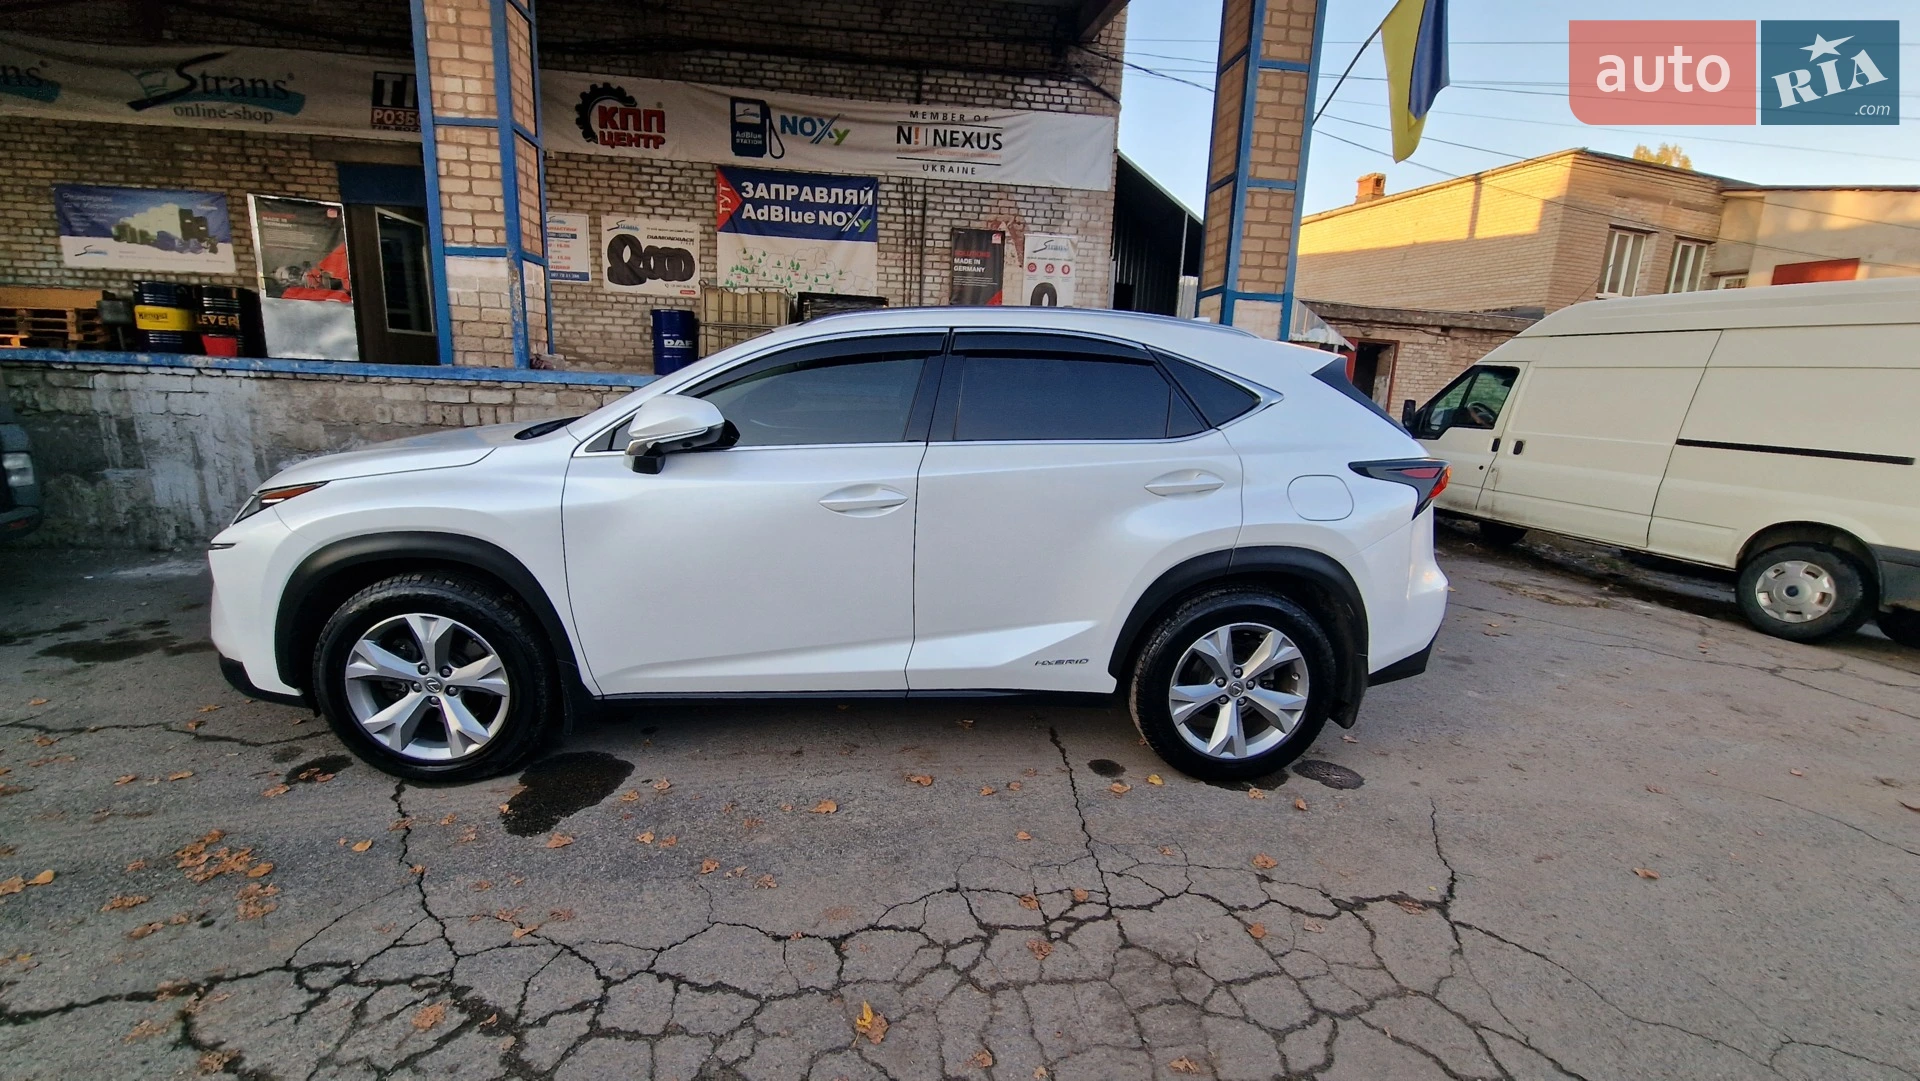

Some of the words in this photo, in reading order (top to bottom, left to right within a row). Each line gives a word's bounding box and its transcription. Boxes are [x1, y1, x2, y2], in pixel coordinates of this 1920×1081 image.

[0, 65, 43, 88] ns
[375, 72, 416, 107] TI
[173, 103, 274, 125] online-shop
[598, 105, 666, 133] КПП
[909, 110, 965, 121] MEMBER
[600, 131, 666, 149] ЦЕНТР
[735, 130, 762, 139] AdBlue
[933, 128, 1003, 151] NEXUS
[922, 164, 976, 175] UKRAINE
[719, 183, 732, 214] ТУТ
[741, 181, 874, 206] ЗАПРАВЛЯЙ
[742, 203, 816, 224] AdBlue
[953, 257, 973, 265] MADE
[953, 265, 986, 273] GERMANY
[1034, 658, 1089, 666] HYBRID
